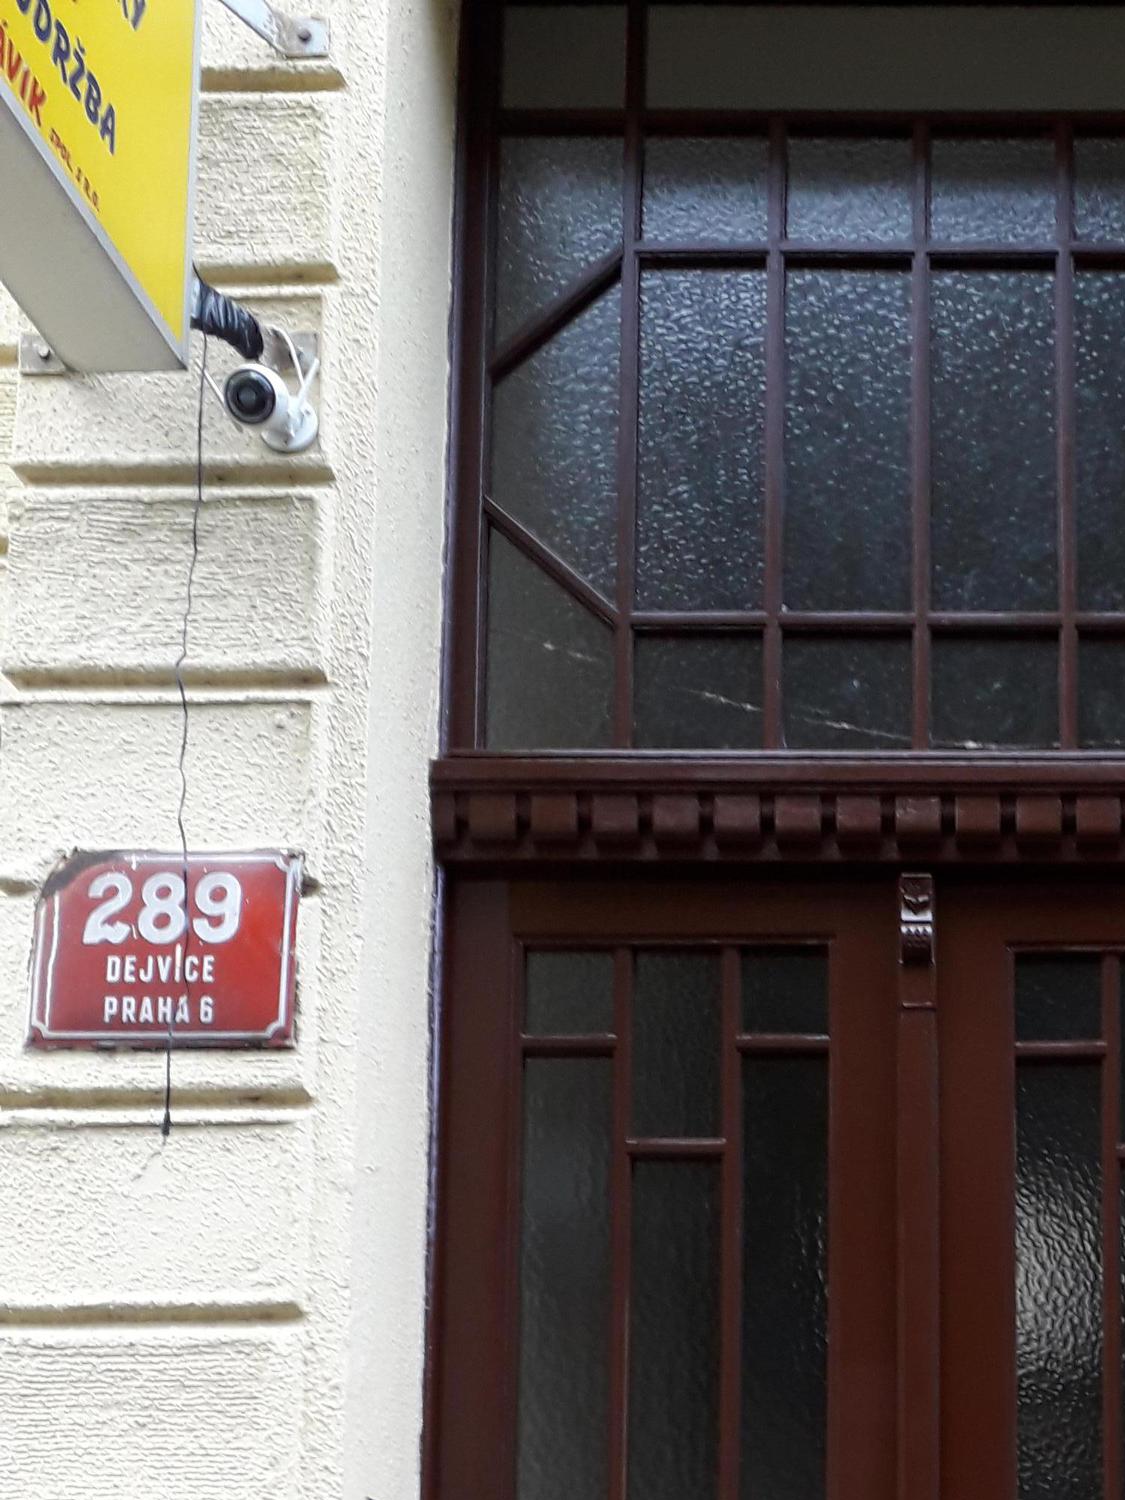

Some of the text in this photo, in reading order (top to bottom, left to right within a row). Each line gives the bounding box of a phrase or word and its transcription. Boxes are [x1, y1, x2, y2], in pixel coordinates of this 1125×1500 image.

[16, 0, 116, 156] DRŽBA
[82, 871, 243, 945] 289
[106, 953, 215, 983] DEJVICE
[104, 996, 214, 1025] PRAHA 6
